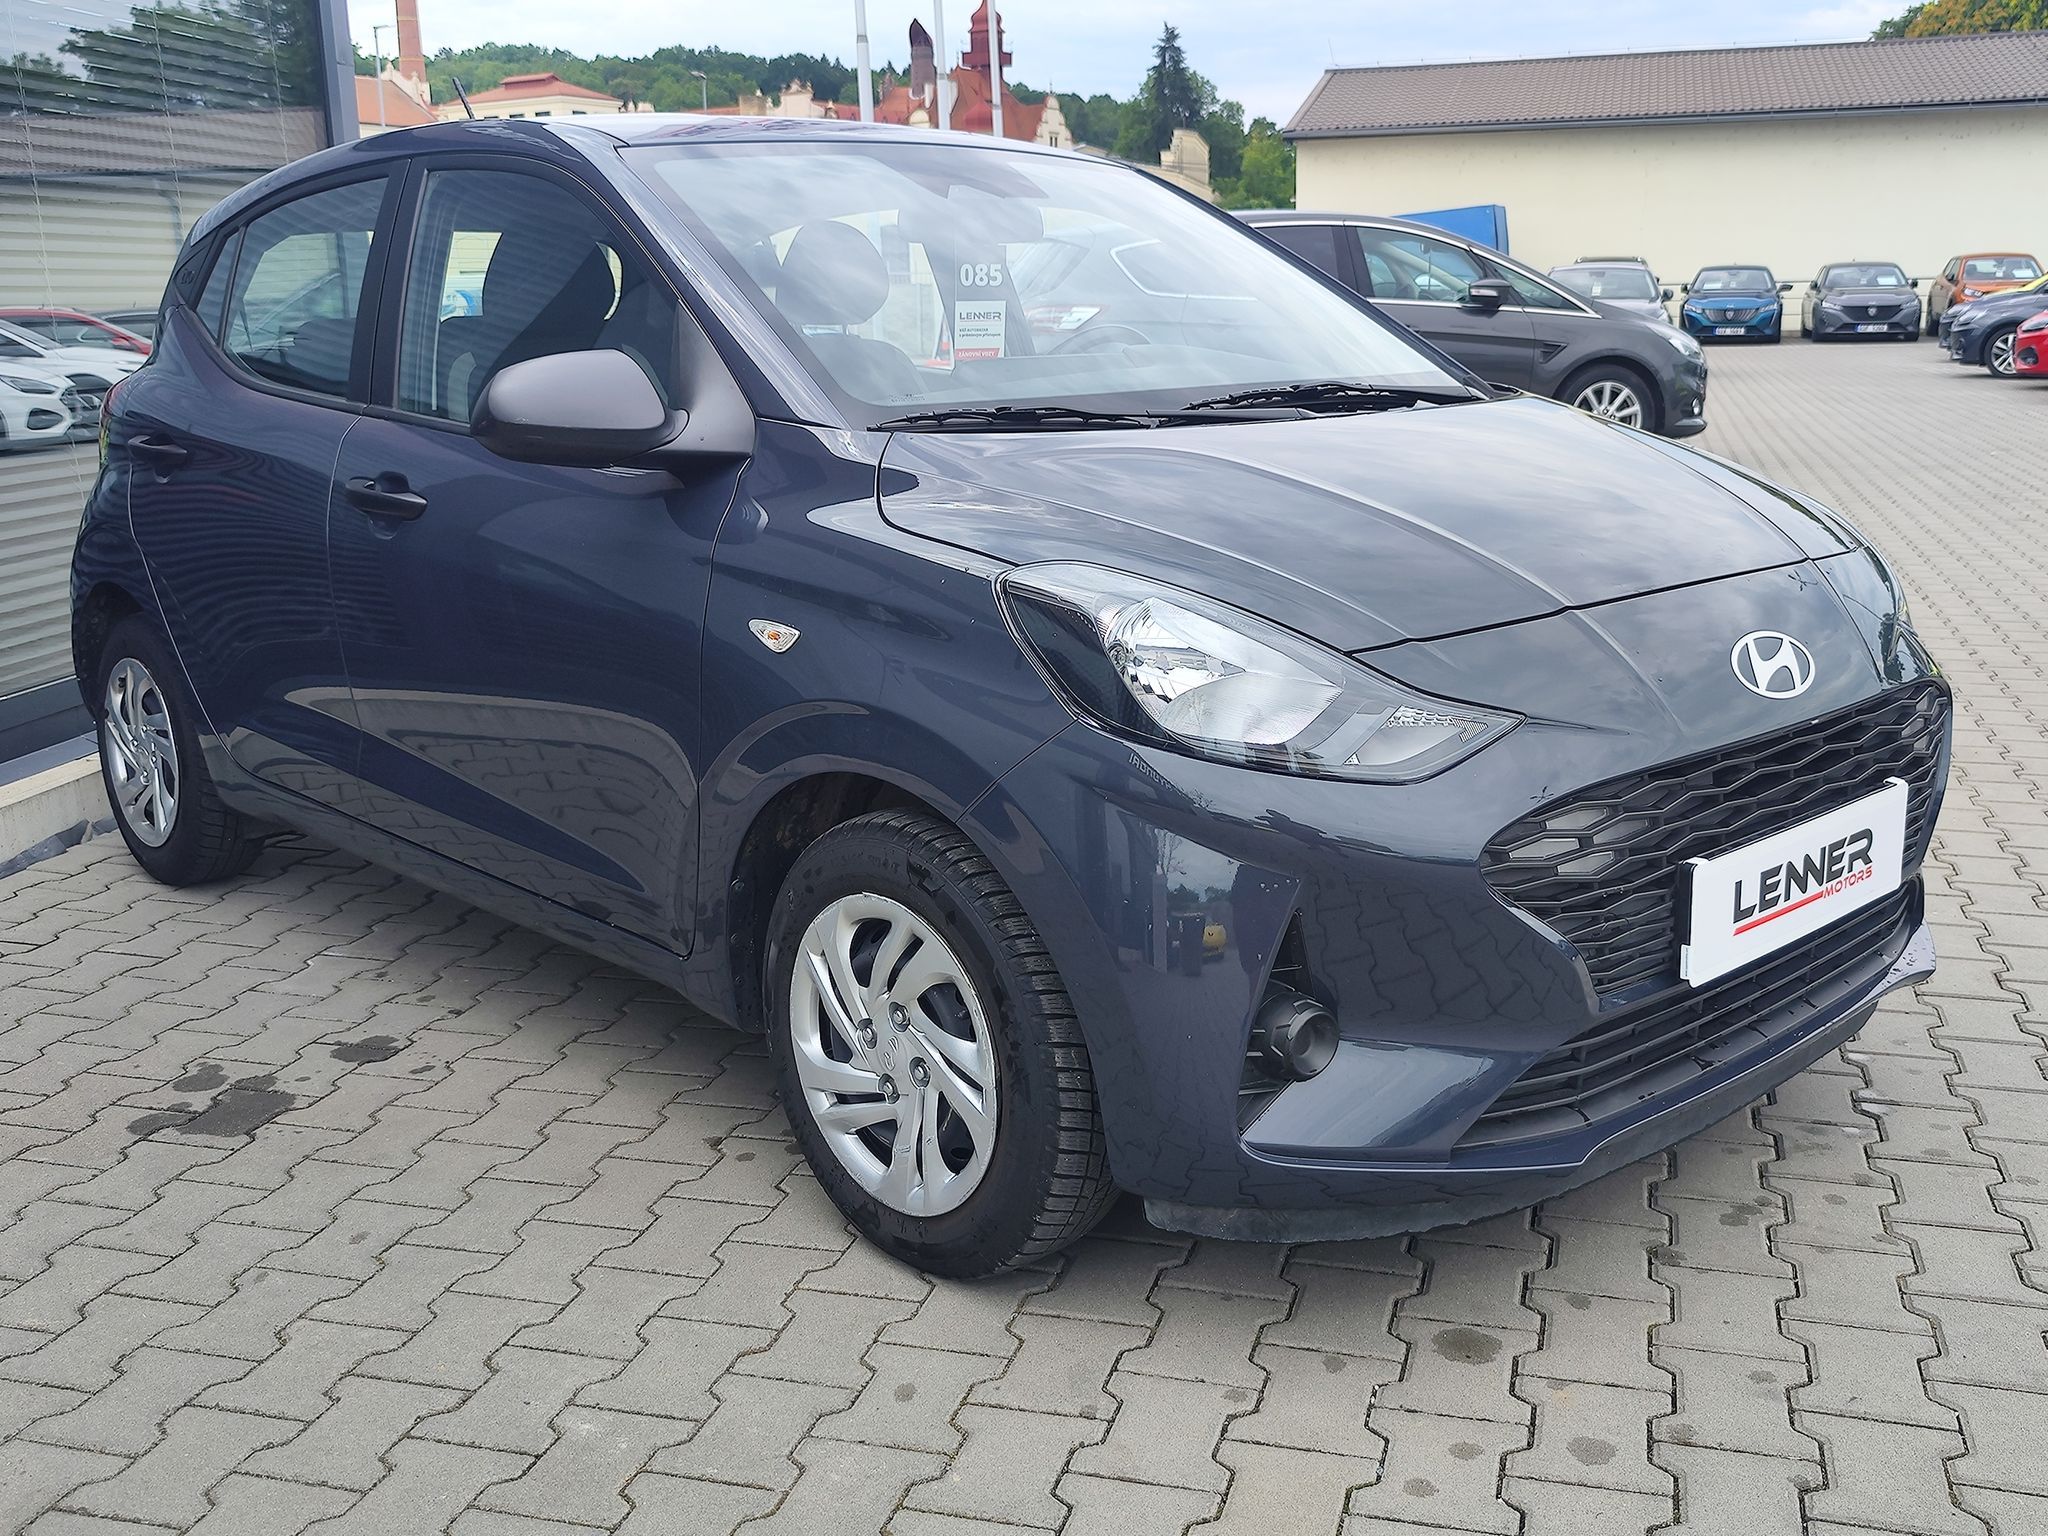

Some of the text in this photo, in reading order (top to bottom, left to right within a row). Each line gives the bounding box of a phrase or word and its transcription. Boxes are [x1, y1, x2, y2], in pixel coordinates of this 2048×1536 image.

[960, 263, 1003, 287] 085
[959, 311, 1002, 322] LENNER
[1733, 828, 1873, 924] LENNER
[1823, 866, 1873, 899] MOTORS
